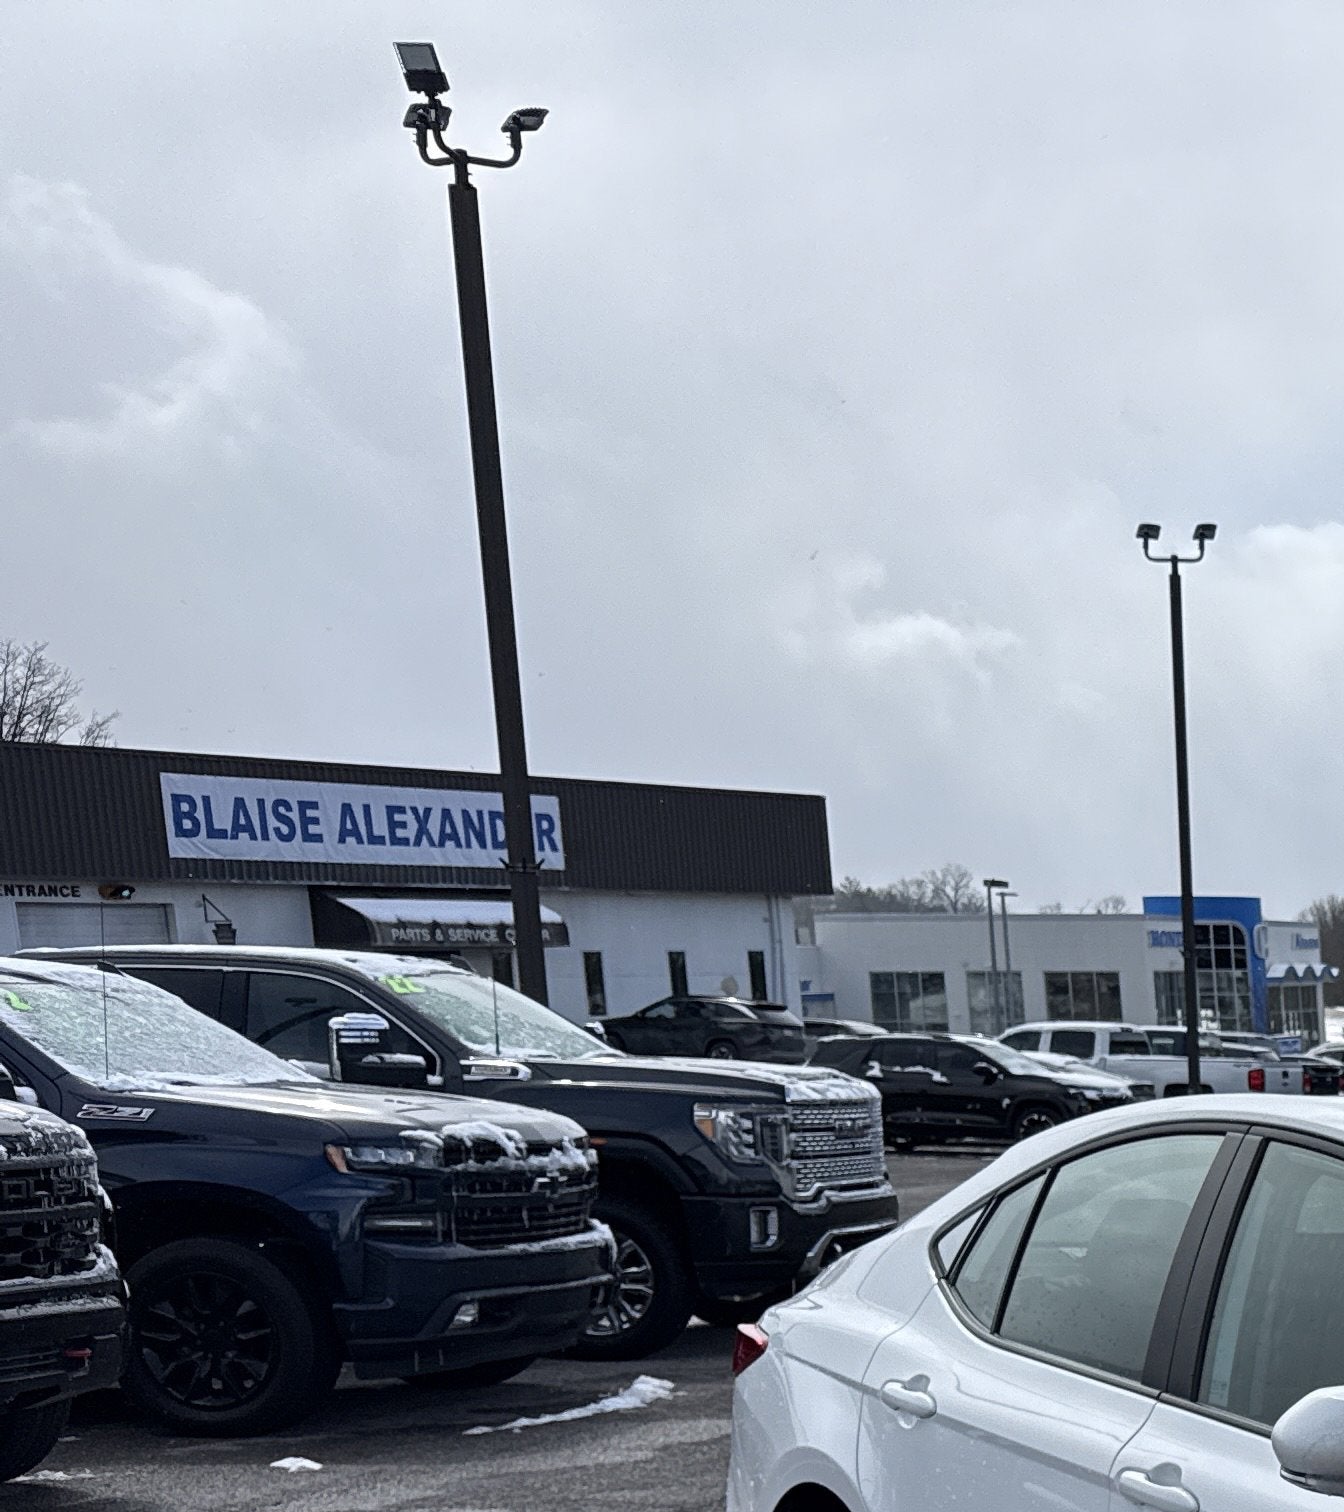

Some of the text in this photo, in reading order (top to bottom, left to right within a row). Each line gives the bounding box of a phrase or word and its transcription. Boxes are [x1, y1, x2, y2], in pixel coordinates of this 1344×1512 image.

[170, 793, 559, 852] BLAISE ALEXANDR
[391, 928, 430, 942] PARTS
[434, 928, 444, 942] &
[449, 928, 499, 942] SERVICE
[76, 1103, 156, 1122] Z71
